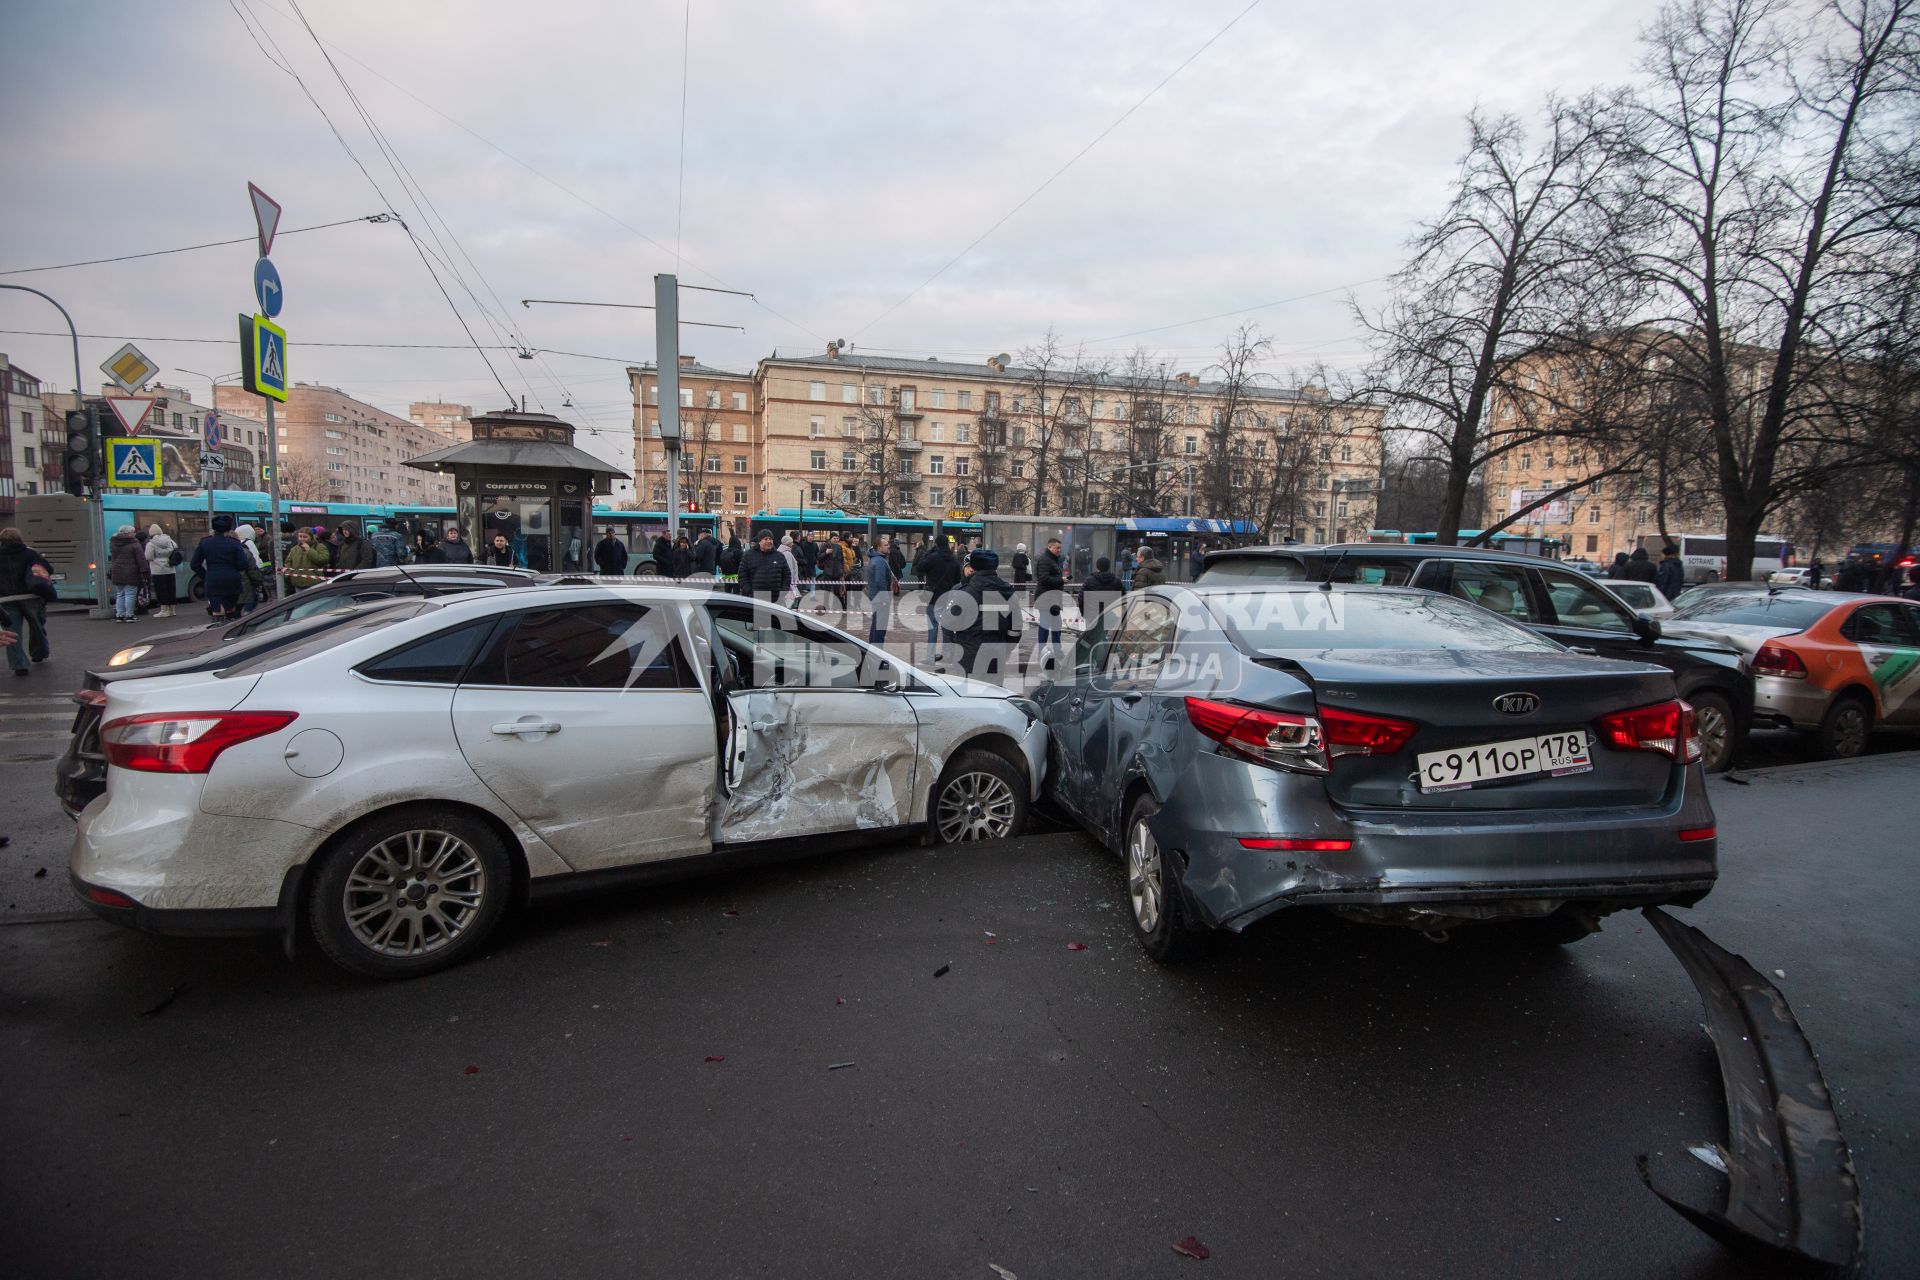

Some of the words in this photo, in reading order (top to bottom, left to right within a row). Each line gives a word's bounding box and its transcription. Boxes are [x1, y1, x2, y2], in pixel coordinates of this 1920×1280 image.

[1688, 557, 1715, 566] SOTRANS
[1502, 697, 1534, 712] KIA
[1540, 734, 1581, 759] 178
[1551, 756, 1572, 766] RUS
